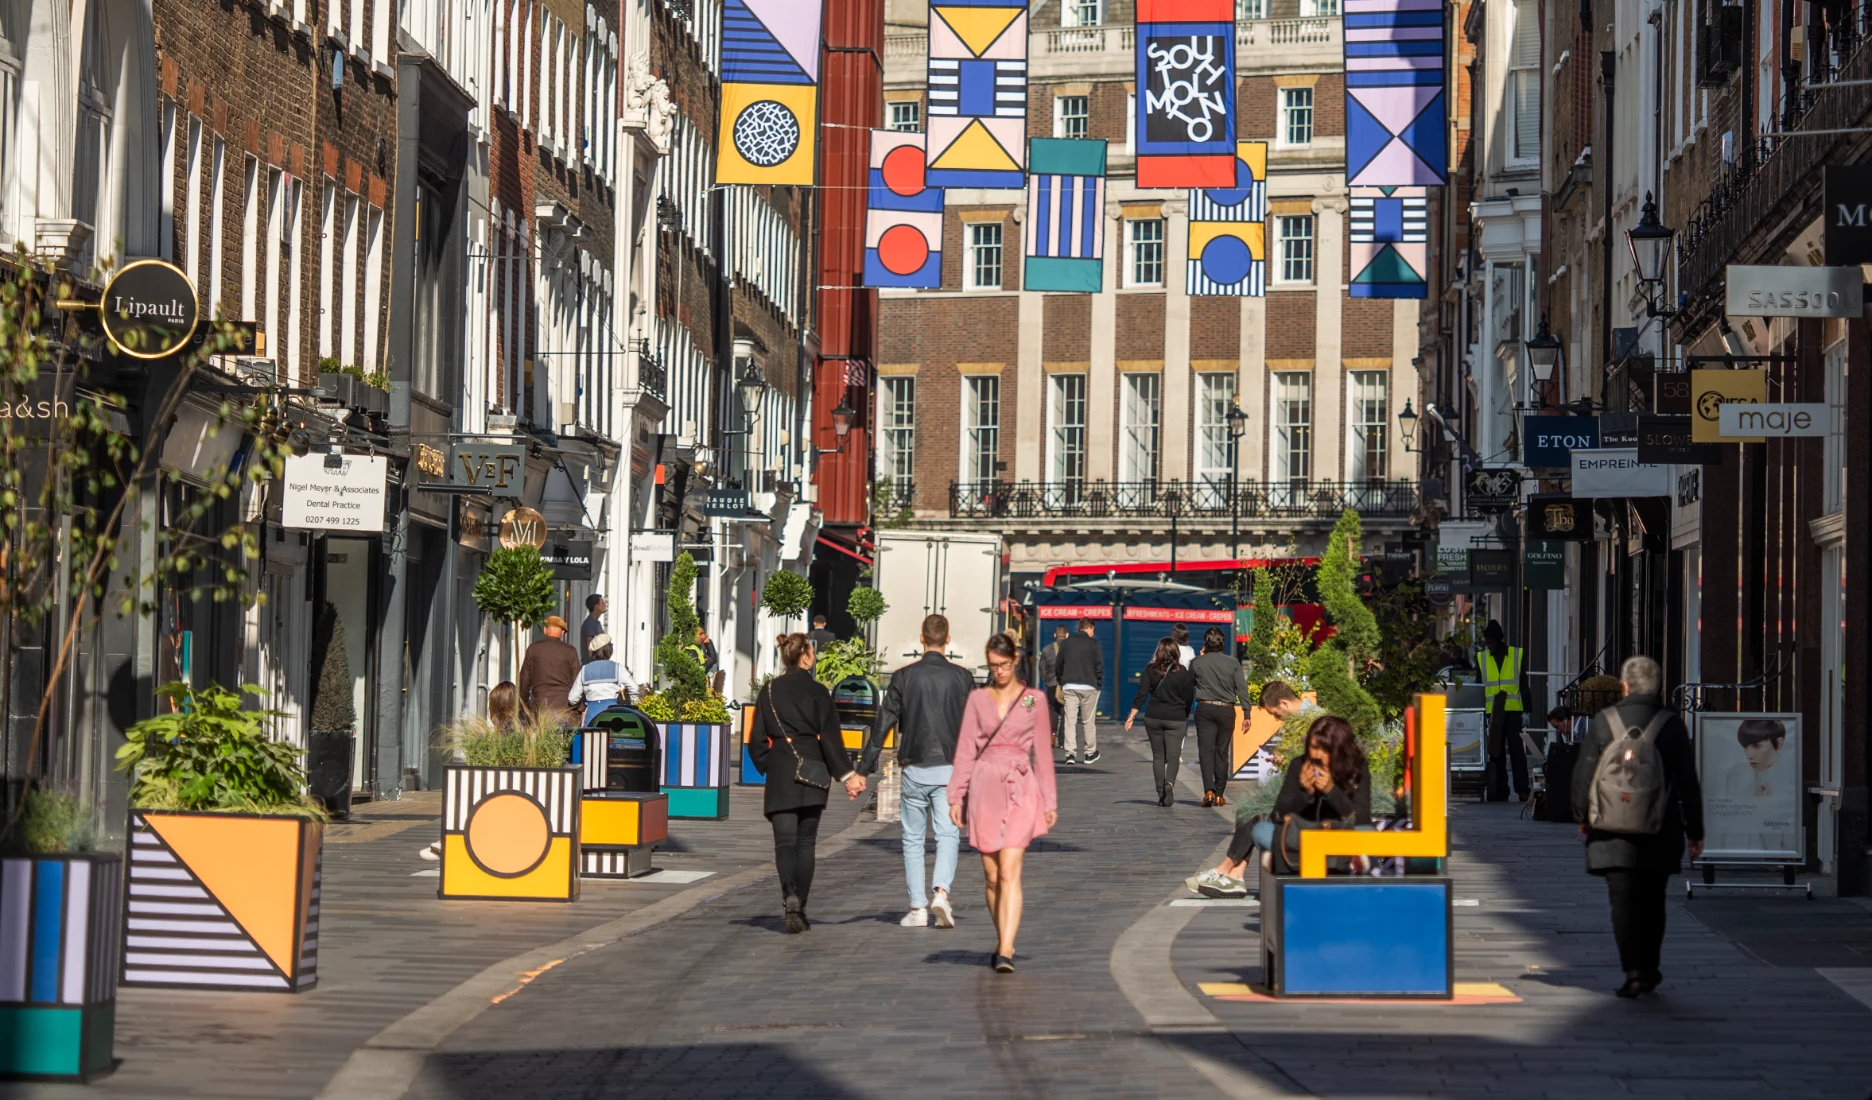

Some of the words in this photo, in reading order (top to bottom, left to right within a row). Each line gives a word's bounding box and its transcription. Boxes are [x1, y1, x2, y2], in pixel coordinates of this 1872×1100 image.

[1147, 35, 1226, 89] SOUTH
[1145, 73, 1226, 143] MOLTON
[1836, 203, 1872, 227] M
[1748, 290, 1860, 309] SASSOON
[115, 296, 185, 318] Lipault
[1663, 382, 1689, 398] 58
[1739, 406, 1812, 434] maje
[1537, 435, 1591, 448] ETON
[289, 483, 308, 492] Nigel
[310, 484, 332, 494] Meyer
[342, 485, 380, 494] Associates
[306, 500, 330, 508] Dental
[332, 500, 361, 510] Practice
[706, 496, 745, 504] LAUDIE
[305, 516, 324, 524] 0207
[325, 516, 340, 524] 499
[342, 517, 360, 525] 1225
[570, 556, 590, 564] LOLA
[1437, 553, 1467, 561] FRESH
[1527, 552, 1563, 560] GOLFINO
[1040, 608, 1052, 617] ICE
[1053, 608, 1078, 617] CREAM
[1083, 608, 1111, 617] CREPES
[1126, 609, 1171, 619] REFRESHMENTS
[1175, 611, 1184, 619] ICE
[1185, 611, 1206, 620] CREAM
[1209, 612, 1233, 621] CREPES
